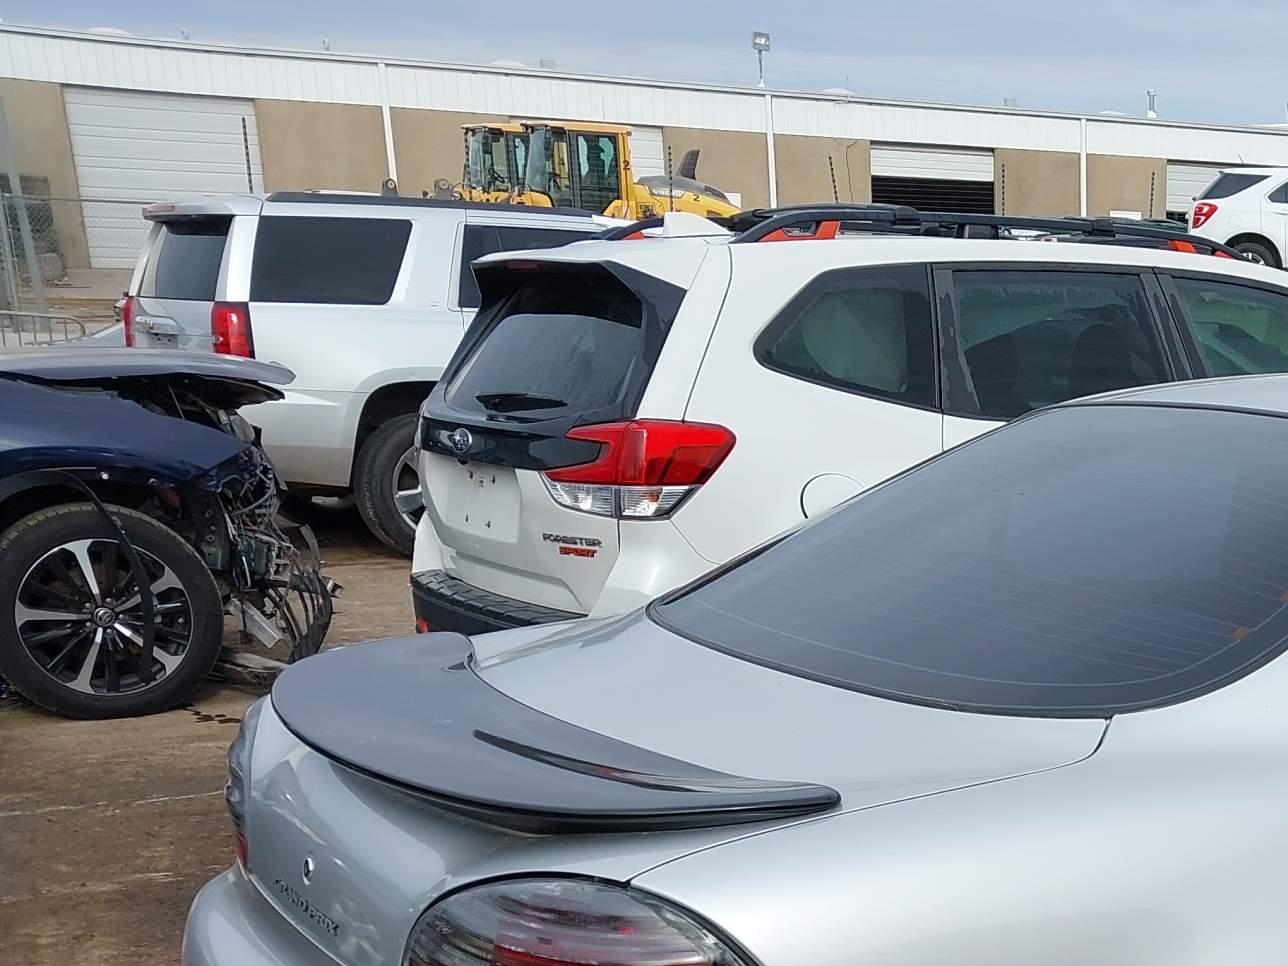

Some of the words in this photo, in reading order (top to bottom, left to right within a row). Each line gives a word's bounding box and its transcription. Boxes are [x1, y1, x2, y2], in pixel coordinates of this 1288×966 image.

[623, 160, 631, 171] 2
[692, 193, 701, 202] 2
[542, 532, 603, 548] FORESTER
[559, 545, 597, 558] SPORT
